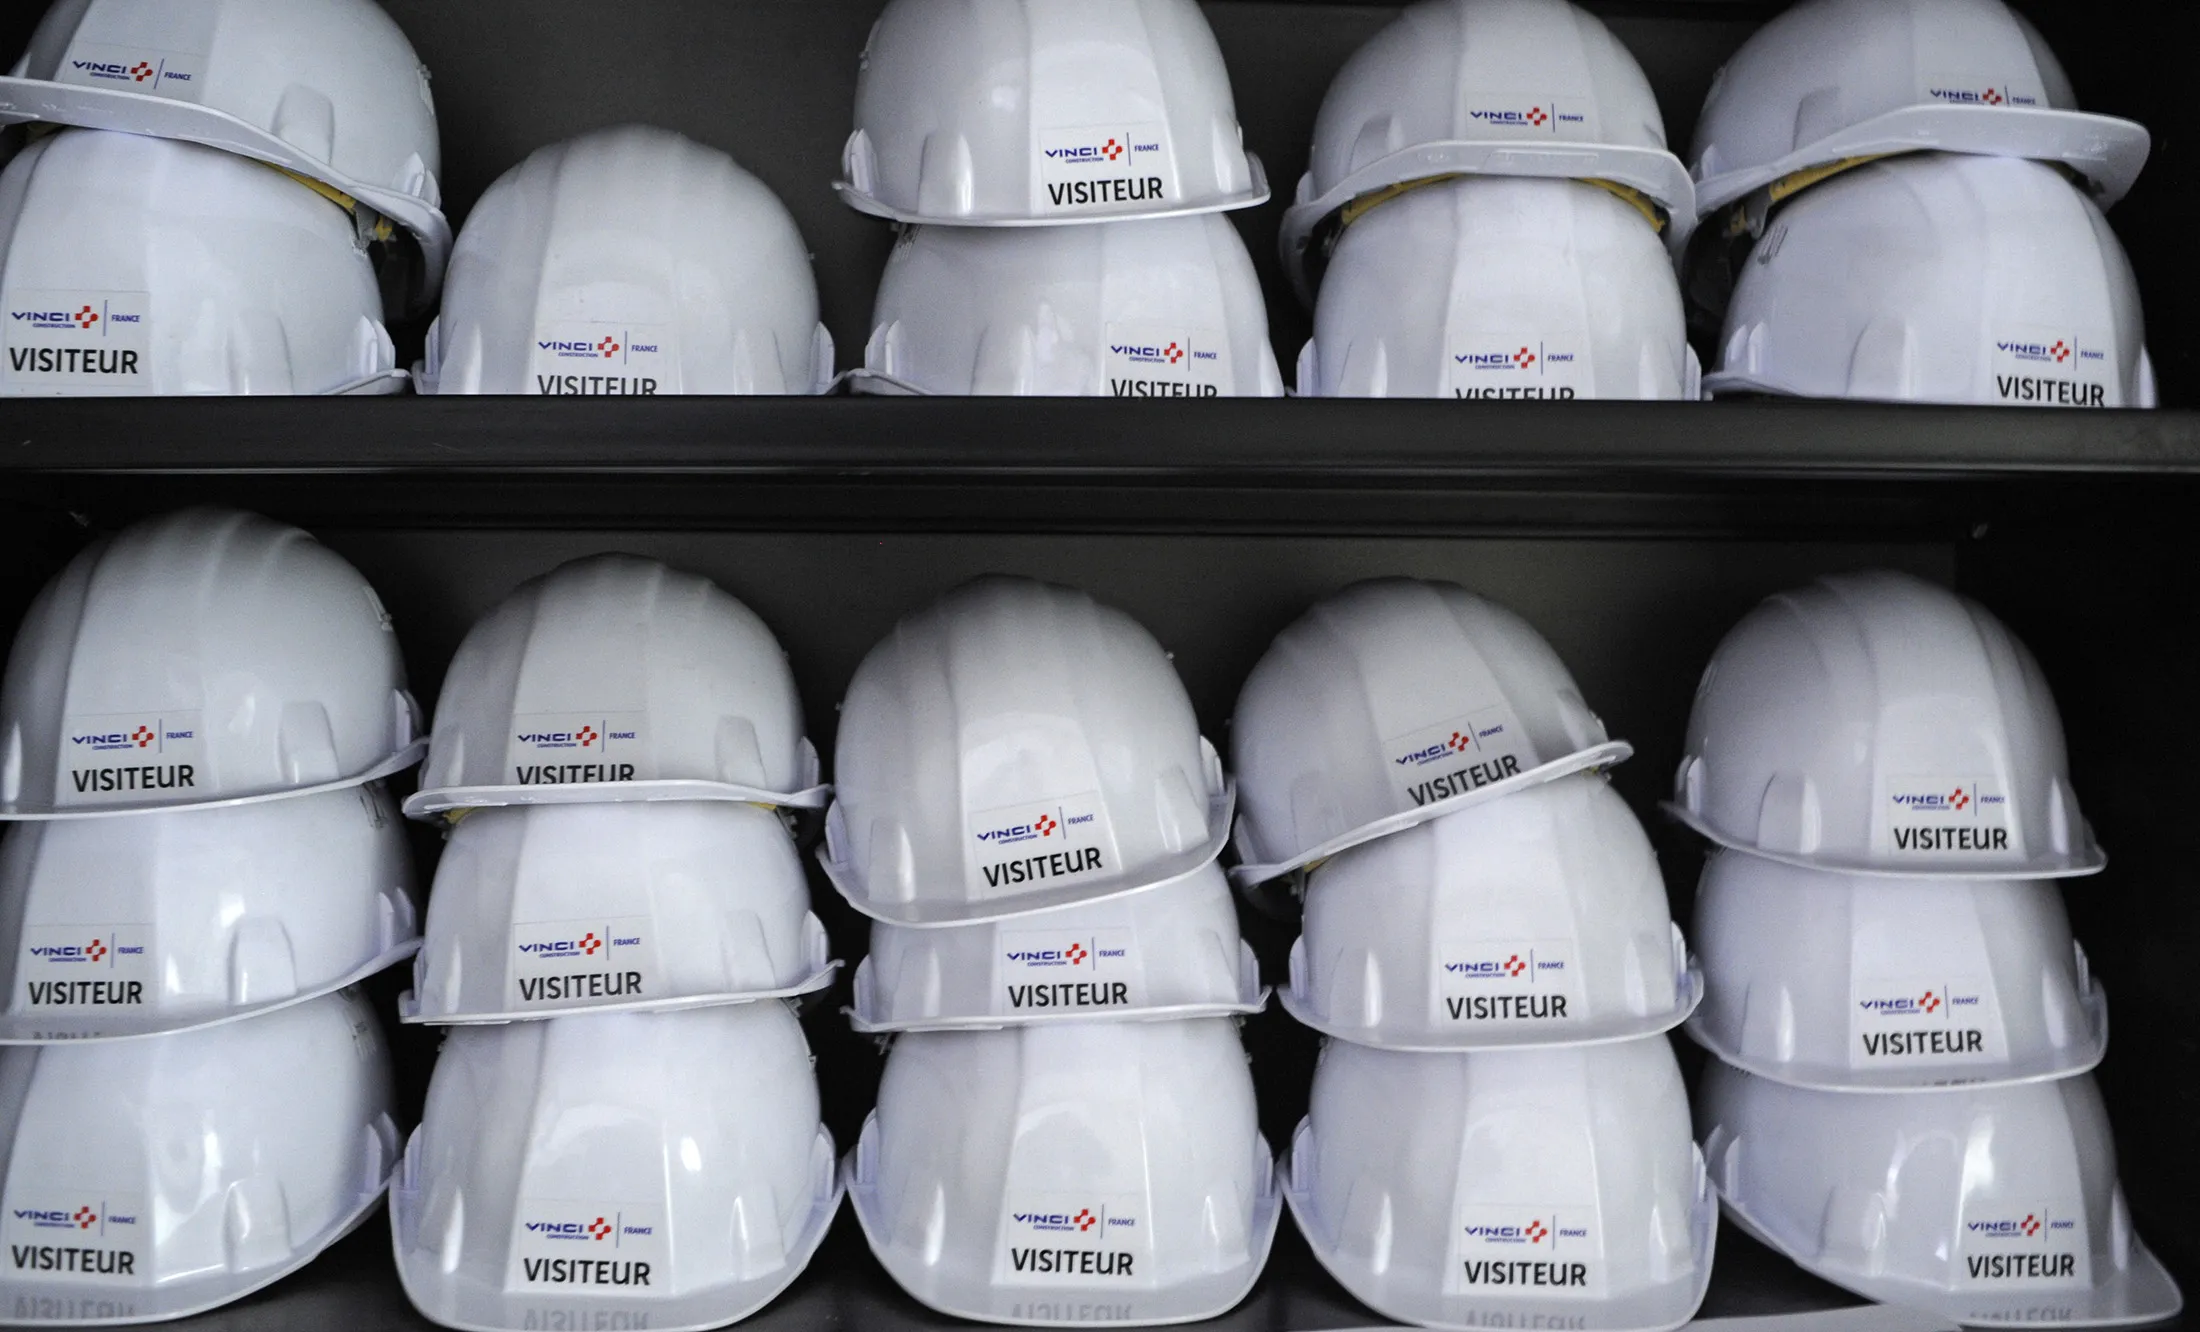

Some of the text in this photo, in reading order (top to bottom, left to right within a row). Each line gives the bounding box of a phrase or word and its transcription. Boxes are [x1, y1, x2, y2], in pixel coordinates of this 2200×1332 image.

[72, 60, 192, 81] VINCI FRANCE
[1470, 111, 1523, 121] VINCI
[1045, 144, 1159, 158] VINCI FRANCE
[1048, 177, 1163, 205] VISITEUR
[11, 311, 140, 322] VINCI FRANCE
[538, 341, 658, 353] VINCI FRANCE
[1111, 345, 1217, 359] VINCI FRANCE
[10, 348, 138, 374] VISITEUR
[1455, 354, 1574, 363] VINCI FRANCE
[537, 375, 657, 395] VISITEUR
[1111, 379, 1217, 397] VISITEUR
[1996, 375, 2104, 407] VISITEUR
[72, 731, 193, 745] VINCI FRANCE
[518, 732, 636, 743] VINCI FRANCE
[1396, 743, 1446, 765] VINCI
[72, 765, 194, 793] VISITEUR
[517, 764, 635, 784] VISITEUR
[1407, 754, 1521, 806] VISITEUR
[1892, 795, 1944, 805] VINCI
[977, 814, 1094, 841] VINCI FRANCE
[1894, 828, 2008, 851] VISITEUR
[983, 847, 1102, 888] VISITEUR
[31, 946, 144, 956] VINCI FRANCE
[519, 937, 640, 953] VINCI FRANCE
[1007, 949, 1125, 961] VINCI FRANCE
[1445, 961, 1564, 972] VINCI FRANCE
[29, 981, 142, 1005] VISITEUR
[519, 972, 642, 1001] VISITEUR
[1008, 982, 1128, 1008] VISITEUR
[1446, 995, 1567, 1020] VISITEUR
[1860, 997, 1978, 1010] VINCI FRANCE
[1863, 1030, 1983, 1056] VISITEUR
[13, 1209, 69, 1221] VINCI
[1013, 1213, 1135, 1227] VINCI FRANCE
[525, 1222, 652, 1235] VINCI FRANCE
[1465, 1226, 1587, 1237] VINCI FRANCE
[1968, 1221, 2016, 1233] VINCI
[11, 1245, 134, 1275] VISITEUR
[1012, 1248, 1133, 1276] VISITEUR
[1967, 1254, 2074, 1278] VISITEUR
[524, 1258, 650, 1286] VISITEUR
[1464, 1261, 1587, 1286] VISITEUR
